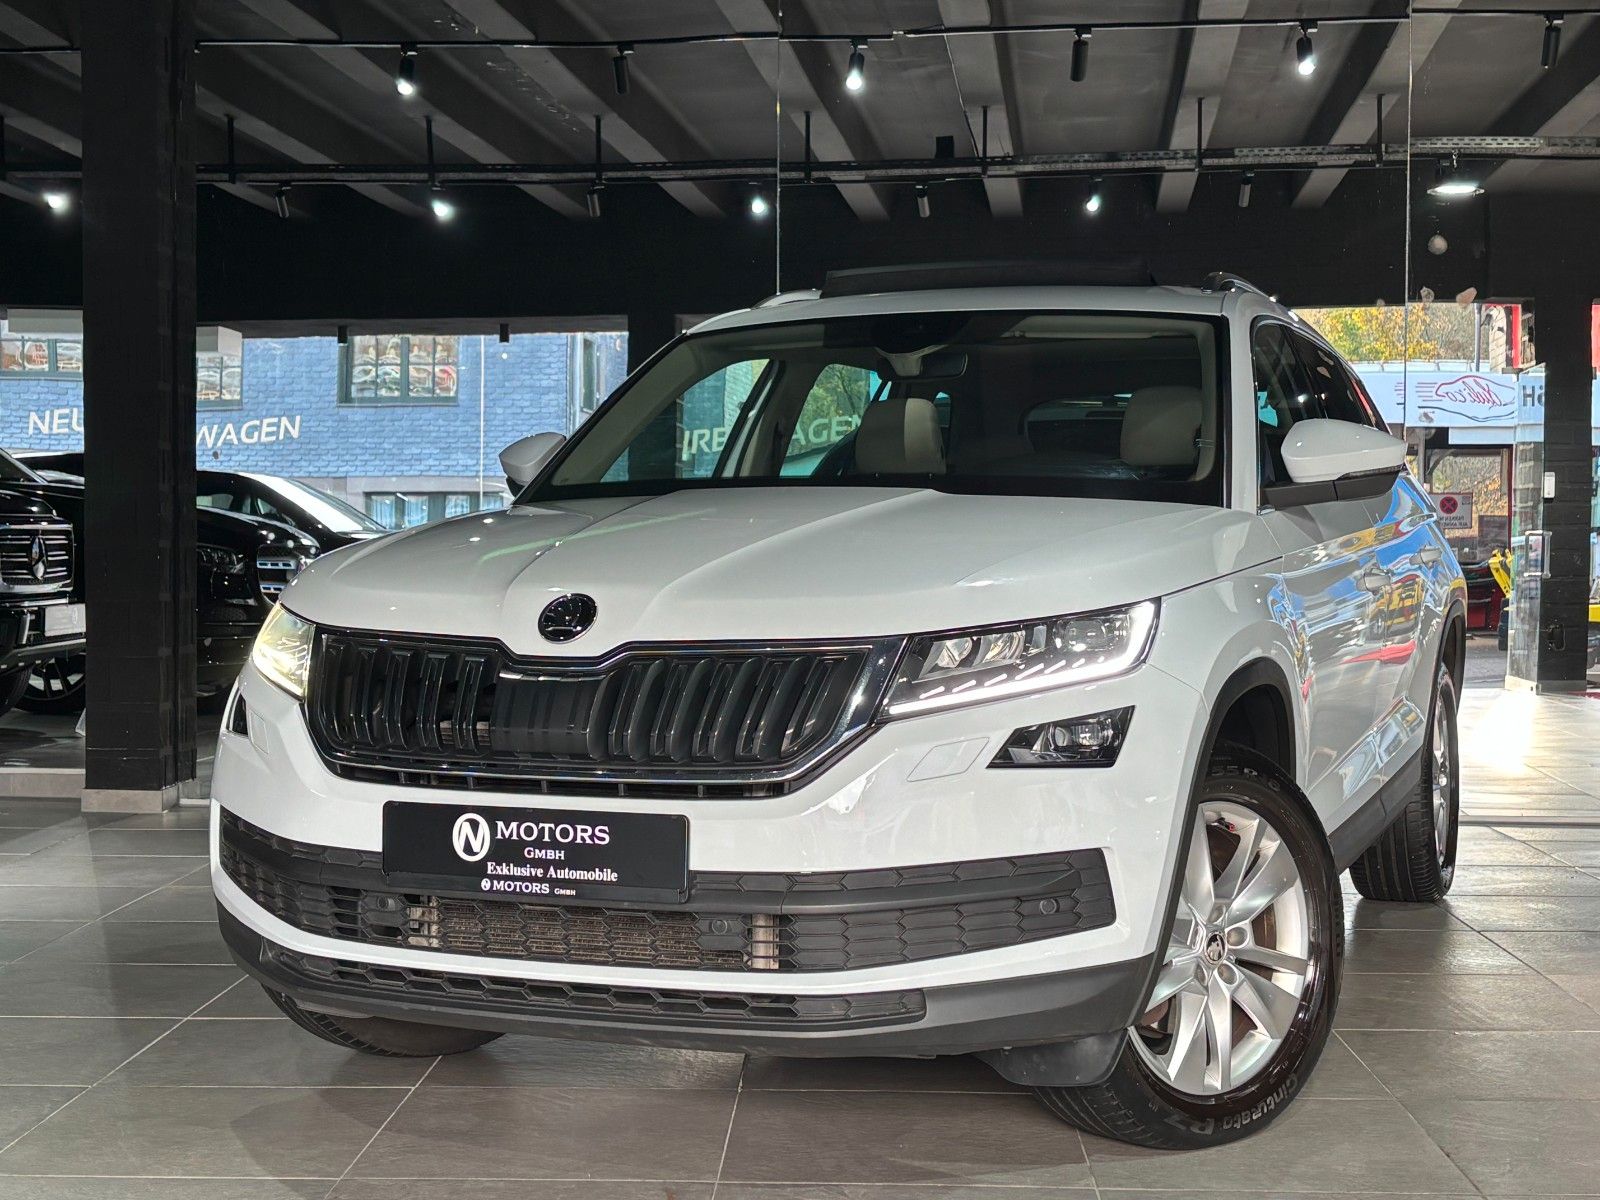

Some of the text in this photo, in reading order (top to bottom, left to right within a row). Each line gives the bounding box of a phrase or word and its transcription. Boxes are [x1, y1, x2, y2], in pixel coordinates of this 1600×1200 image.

[495, 821, 610, 845] MOTORS
[524, 847, 565, 860] GMBH
[487, 861, 618, 882] Exklusive Automobile
[493, 880, 550, 894] MOTORS
[554, 887, 576, 896] GMBH
